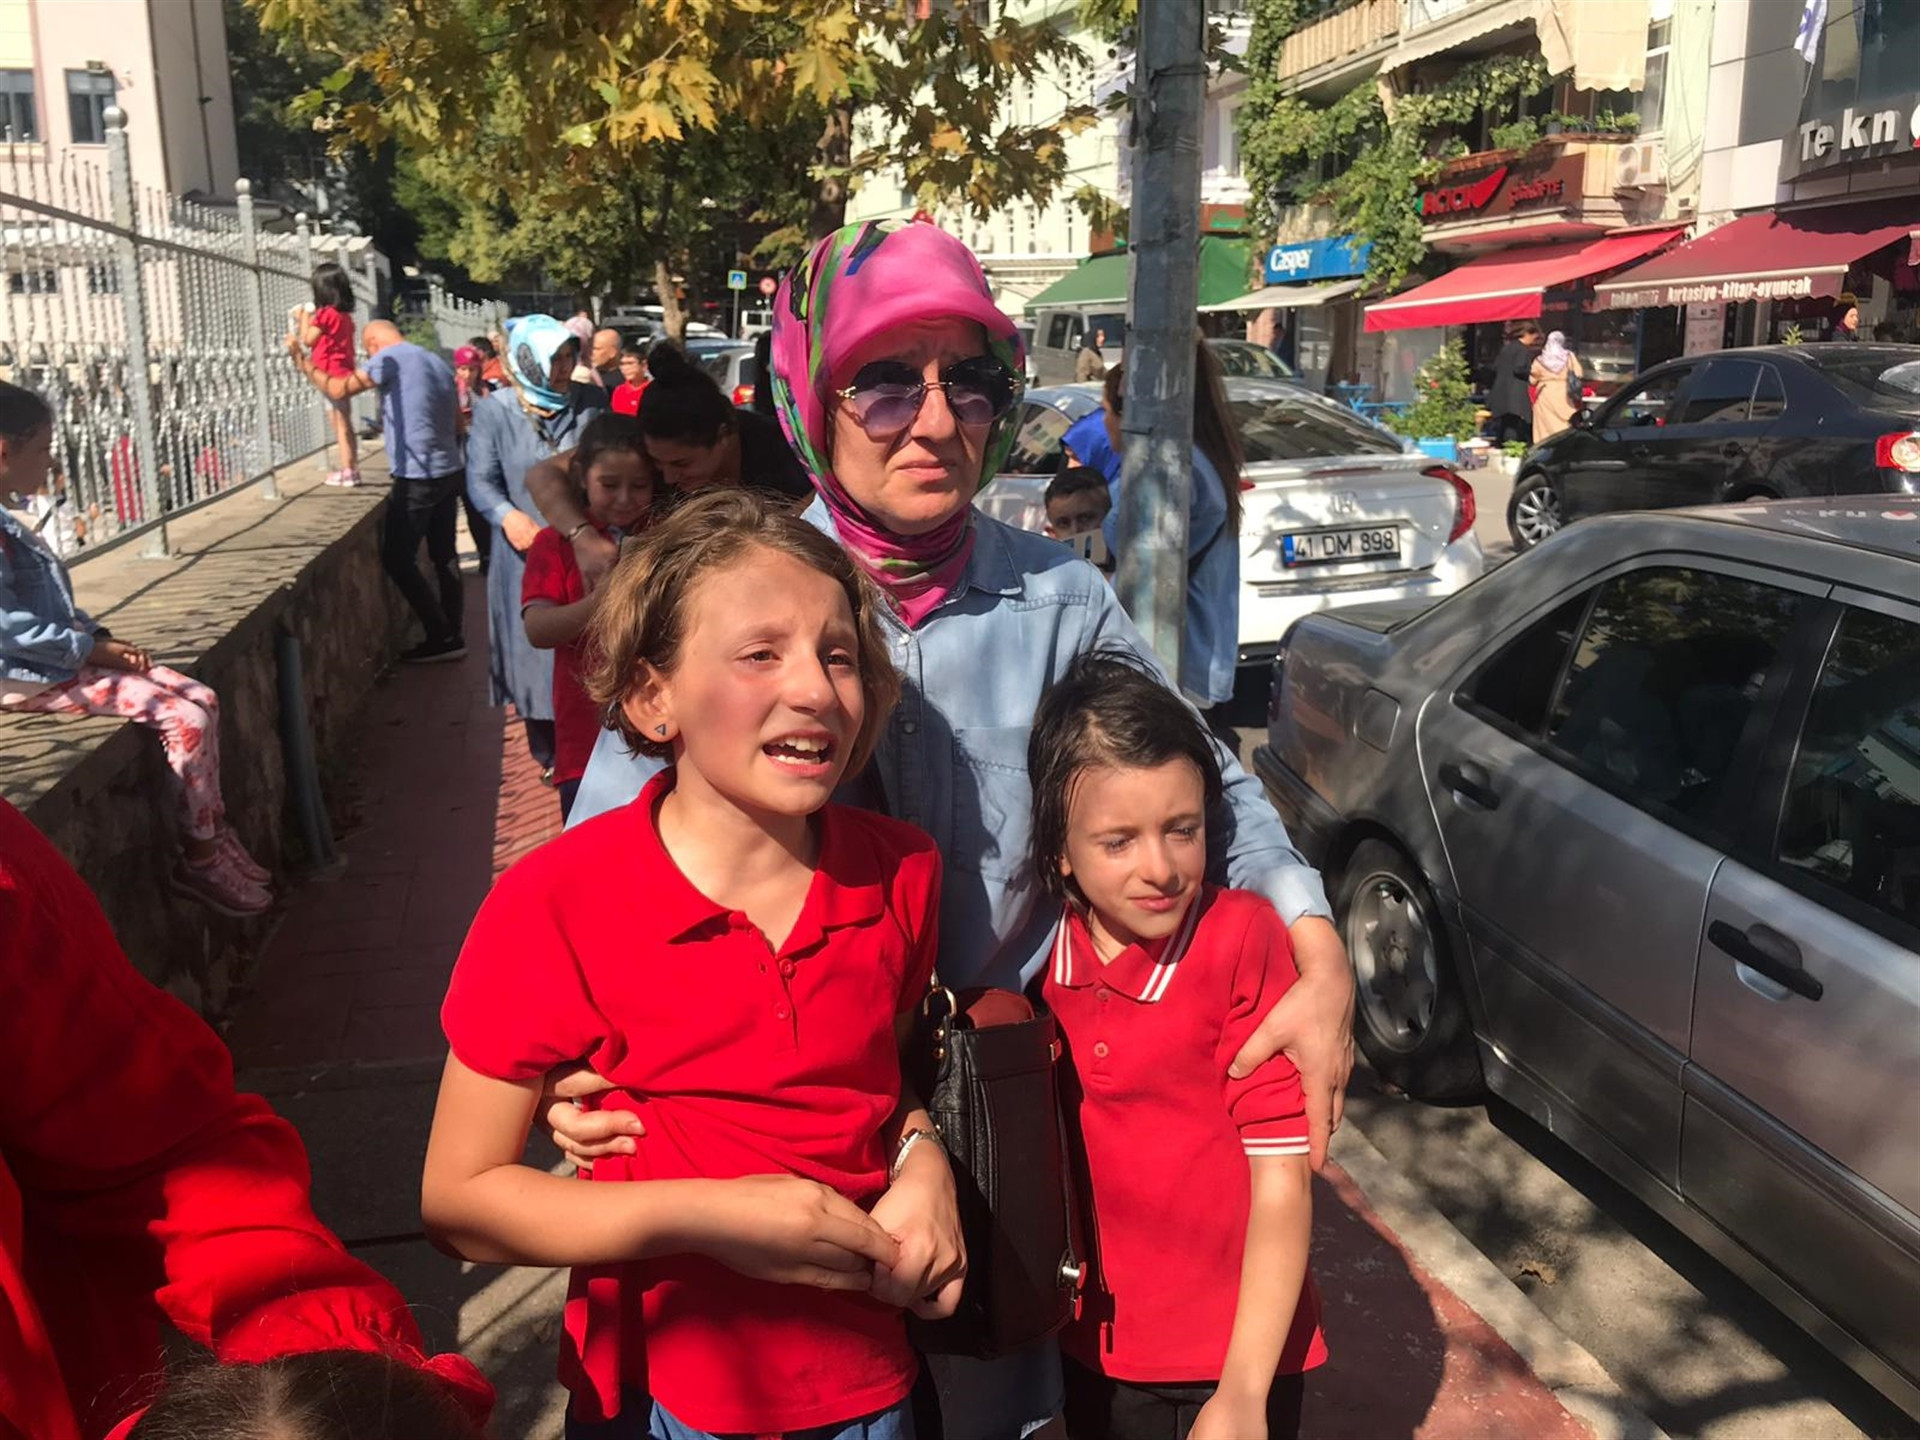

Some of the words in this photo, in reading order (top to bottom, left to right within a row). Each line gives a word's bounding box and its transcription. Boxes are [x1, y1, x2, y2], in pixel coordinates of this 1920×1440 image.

[1270, 248, 1313, 276] Casper
[1295, 537, 1313, 558] 41
[1322, 534, 1353, 556] DM
[1360, 530, 1394, 551] 898
